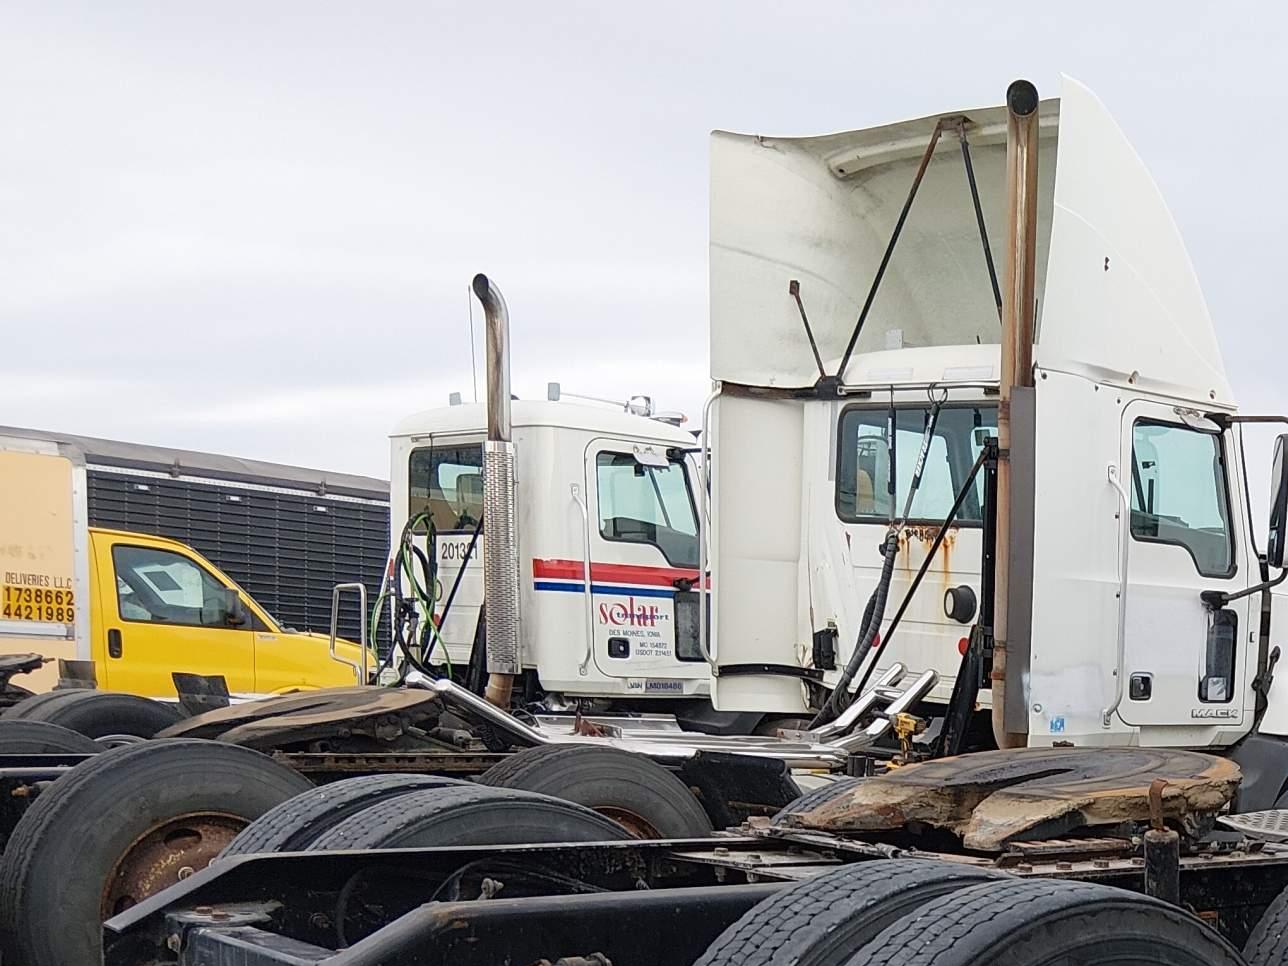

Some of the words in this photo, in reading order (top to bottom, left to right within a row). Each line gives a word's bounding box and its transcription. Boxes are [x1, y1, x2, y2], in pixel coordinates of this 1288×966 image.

[5, 572, 50, 587] DELIVERIES
[5, 586, 75, 606] 1738662
[3, 603, 75, 622] 4421989
[599, 597, 659, 627] solar
[1191, 709, 1238, 718] MACK
